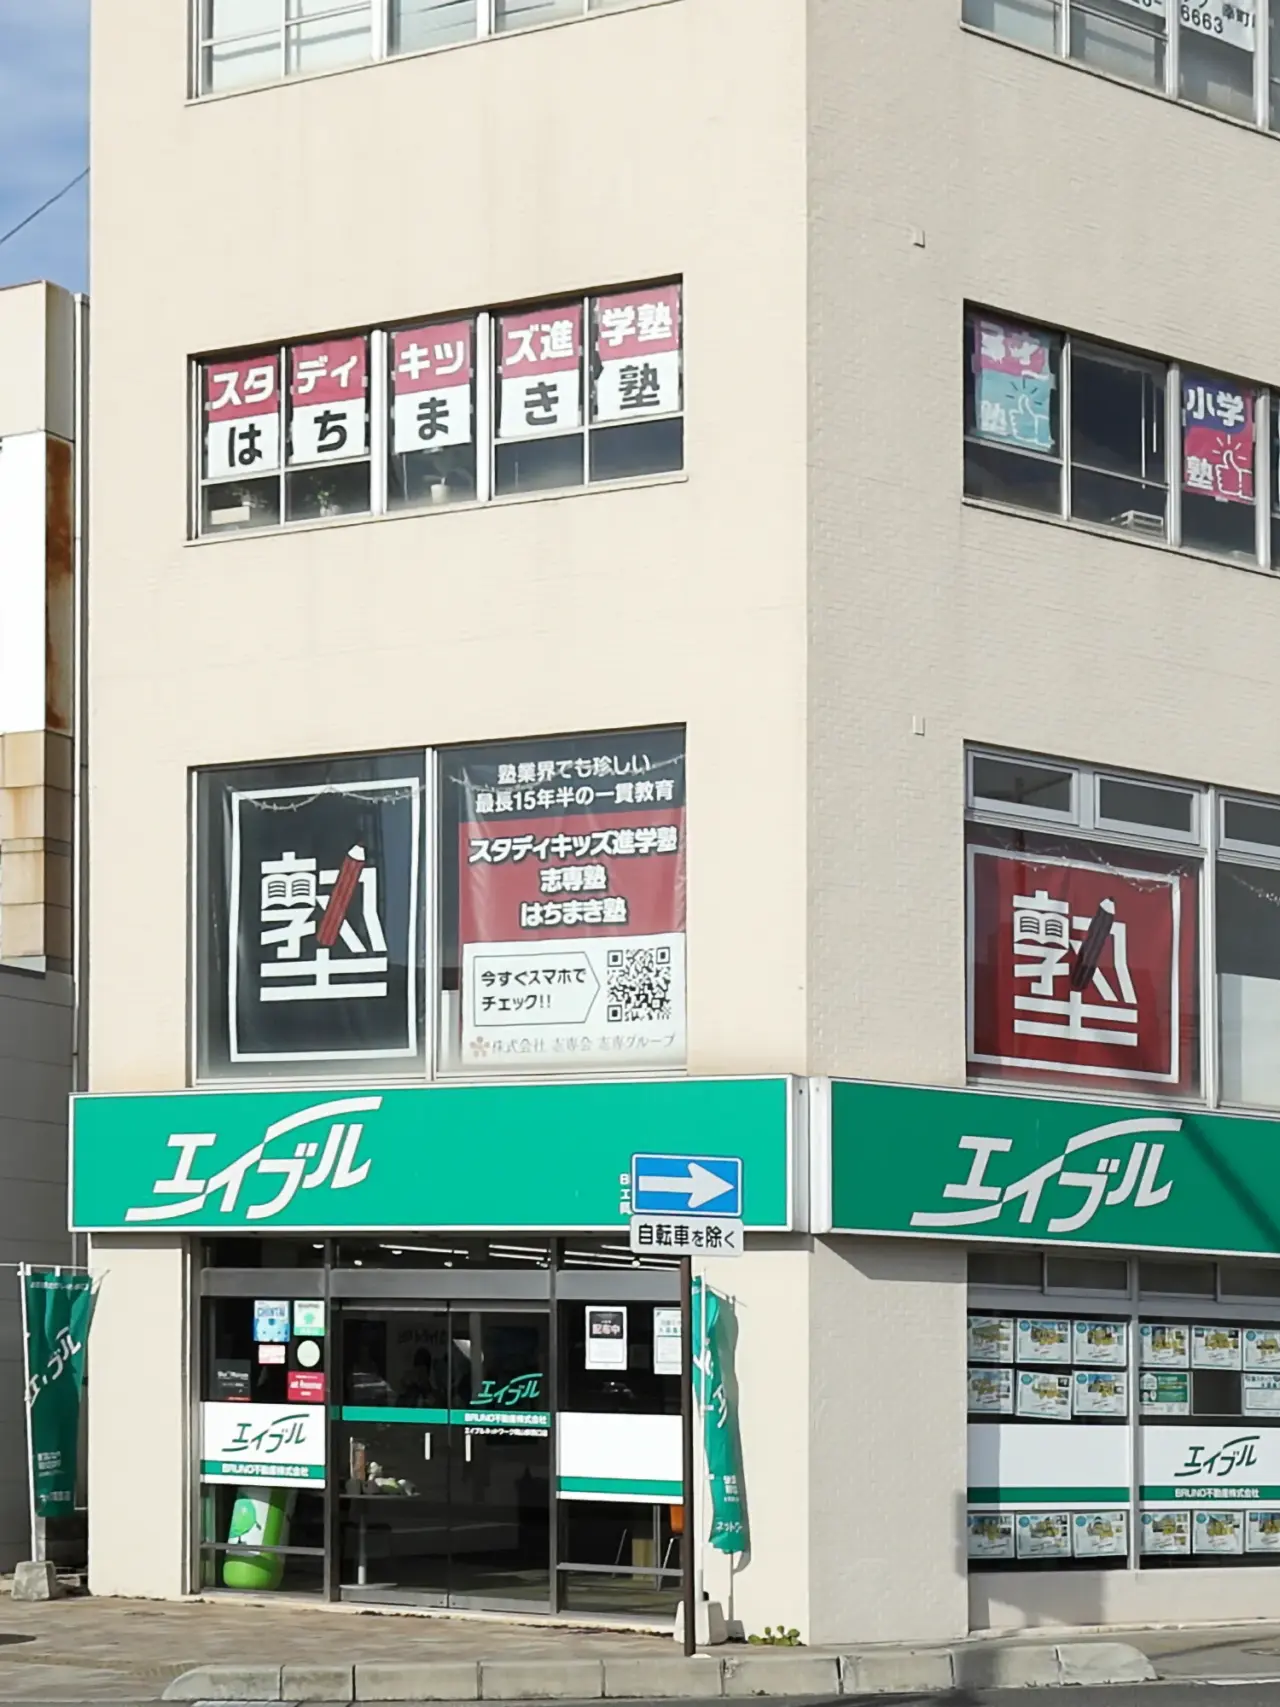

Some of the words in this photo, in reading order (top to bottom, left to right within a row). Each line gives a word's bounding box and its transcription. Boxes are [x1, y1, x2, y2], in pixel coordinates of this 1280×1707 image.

[1180, 4, 1224, 34] 6663
[1187, 386, 1245, 427] 小学
[1187, 455, 1214, 491] 塾
[498, 754, 651, 785] 塾業界でも珍しい
[476, 779, 674, 814] 最長15年半の一貫教育
[468, 826, 678, 864] スタディキッズ進学塾
[539, 864, 607, 893] 志専塾
[520, 897, 627, 927] はちまき塾
[481, 967, 587, 987] 今すぐスマホで
[124, 1096, 384, 1222] エイブル
[909, 1117, 1183, 1233] エイブル
[638, 1223, 735, 1249] 自転車を除く
[469, 1373, 543, 1405] エイブル
[221, 1413, 310, 1453] エイブル
[1173, 1435, 1261, 1477] エイブル
